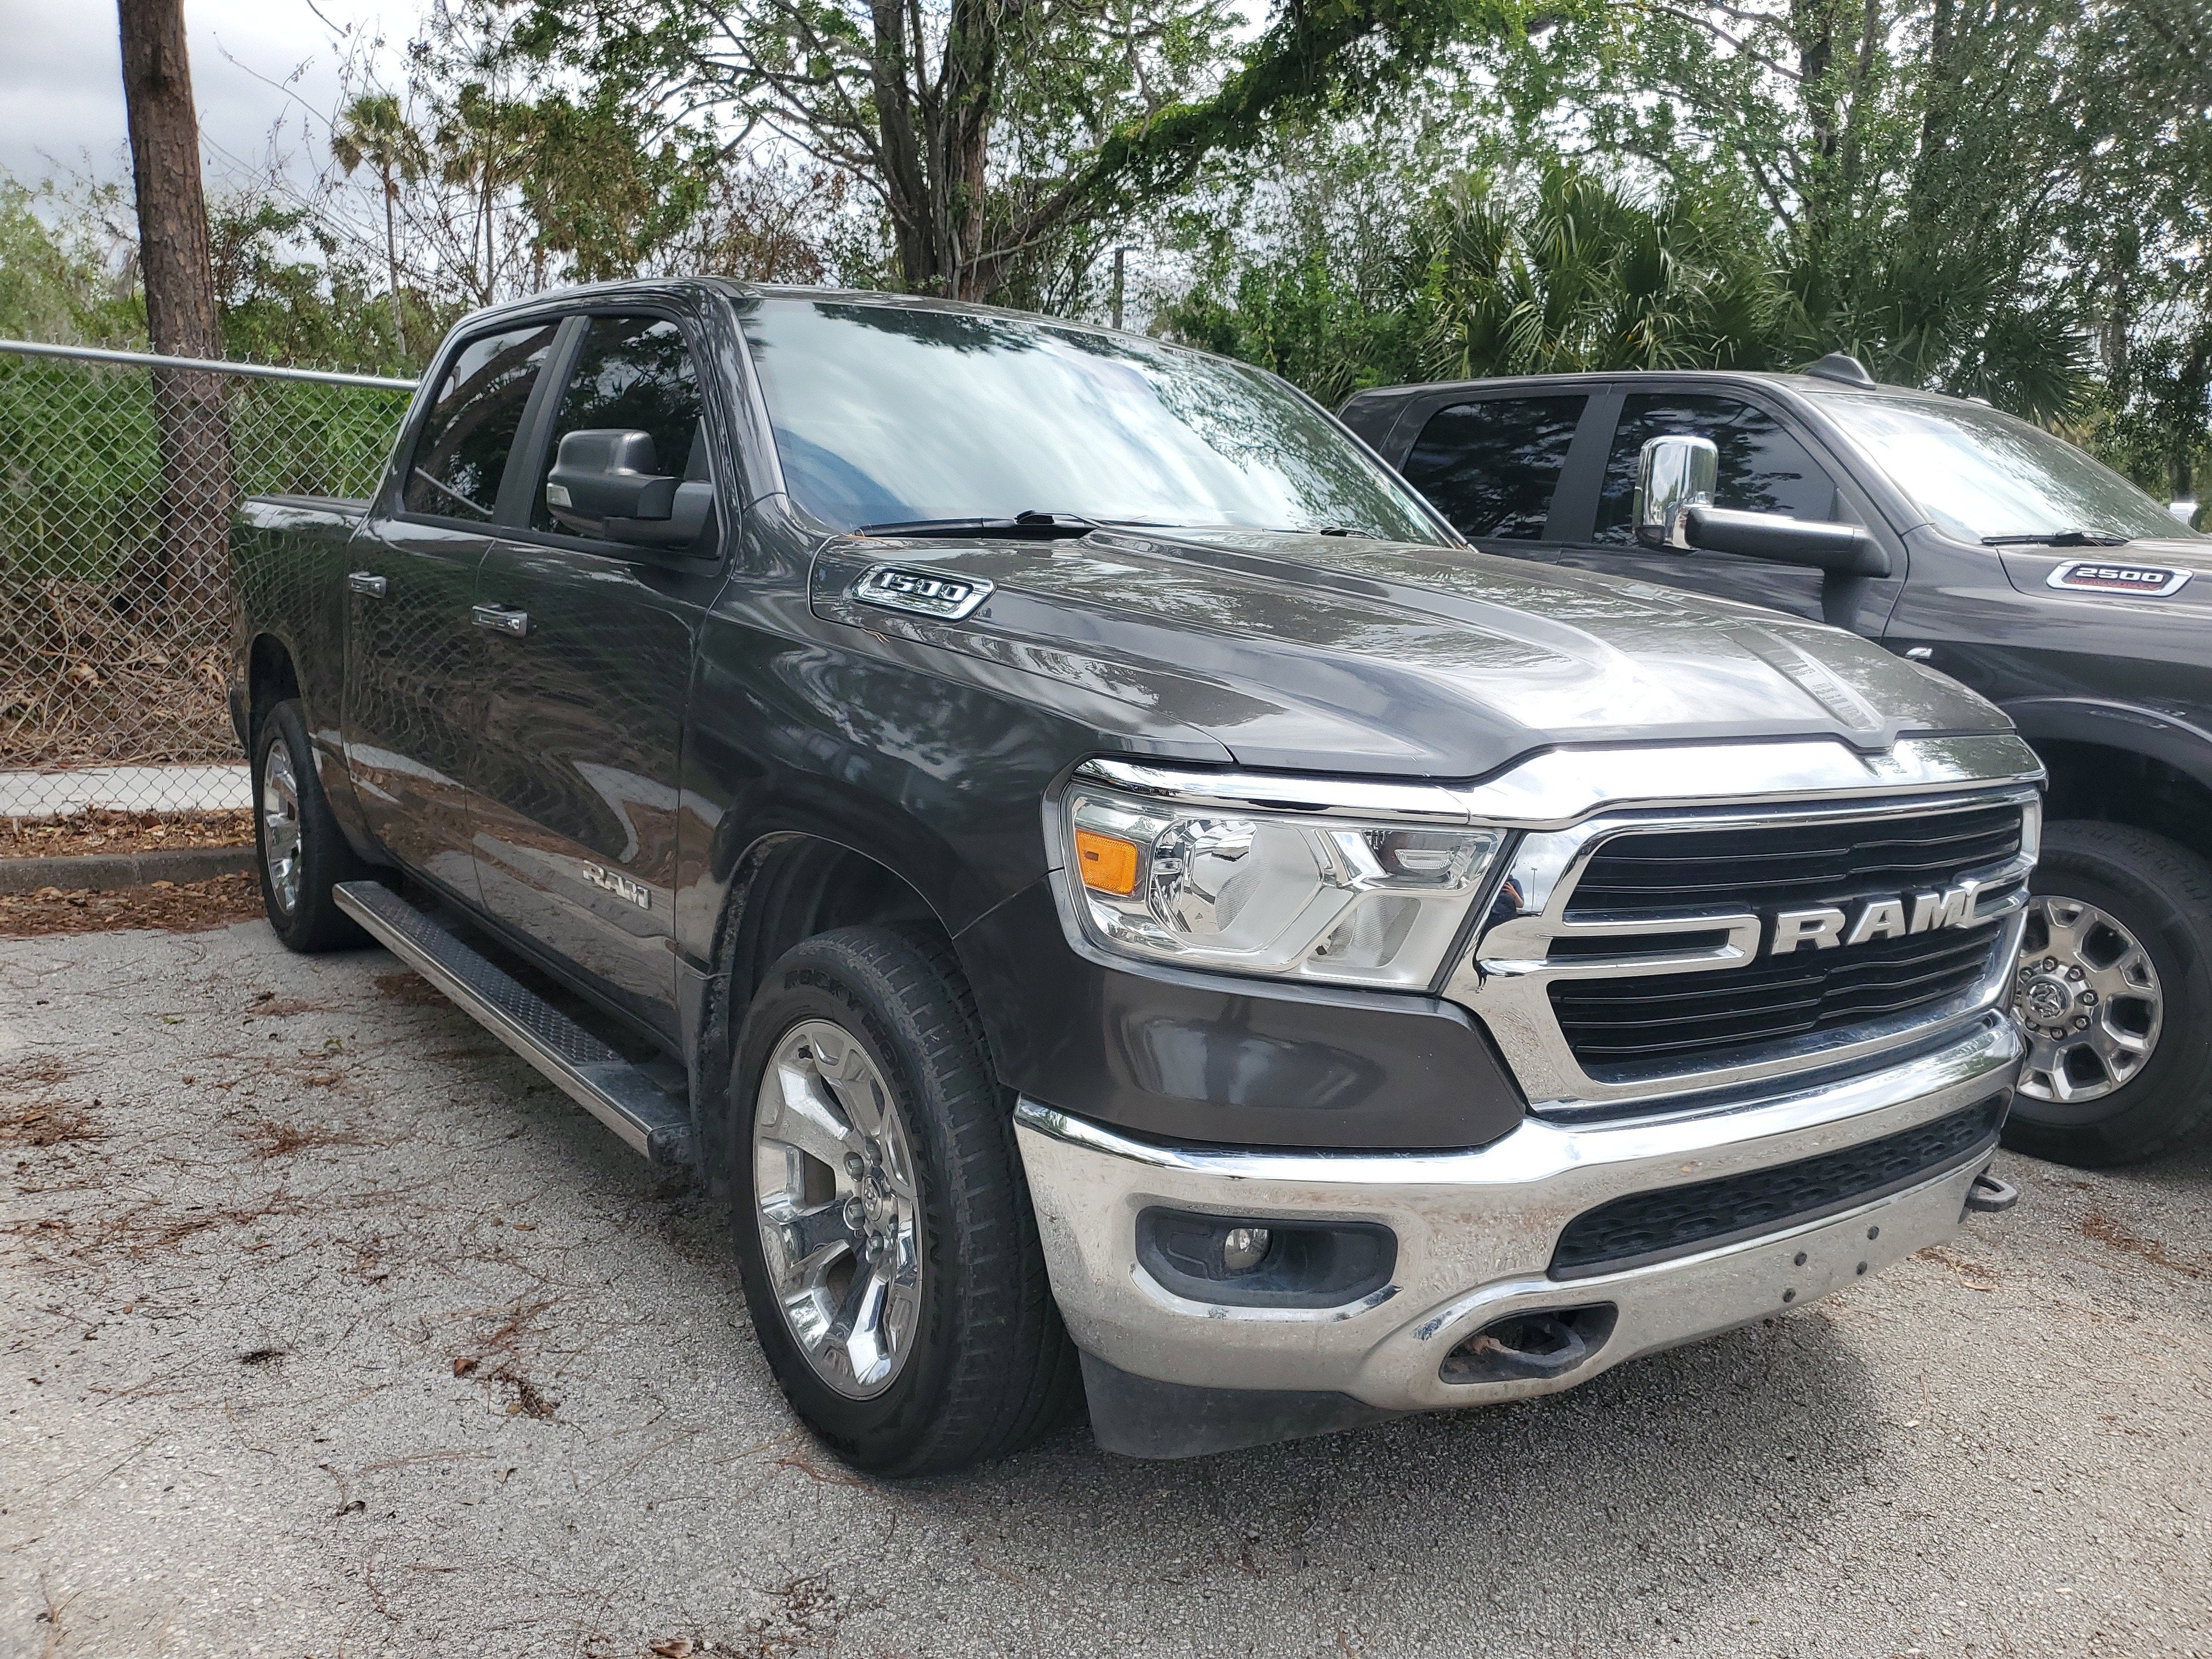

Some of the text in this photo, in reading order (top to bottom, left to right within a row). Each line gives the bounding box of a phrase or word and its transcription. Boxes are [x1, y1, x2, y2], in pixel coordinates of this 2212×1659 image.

[879, 572, 970, 601] 1500
[2076, 567, 2163, 583] 2500
[583, 859, 652, 910] RAM
[1771, 885, 1970, 955] RAM
[784, 968, 862, 1011] ROCKY
